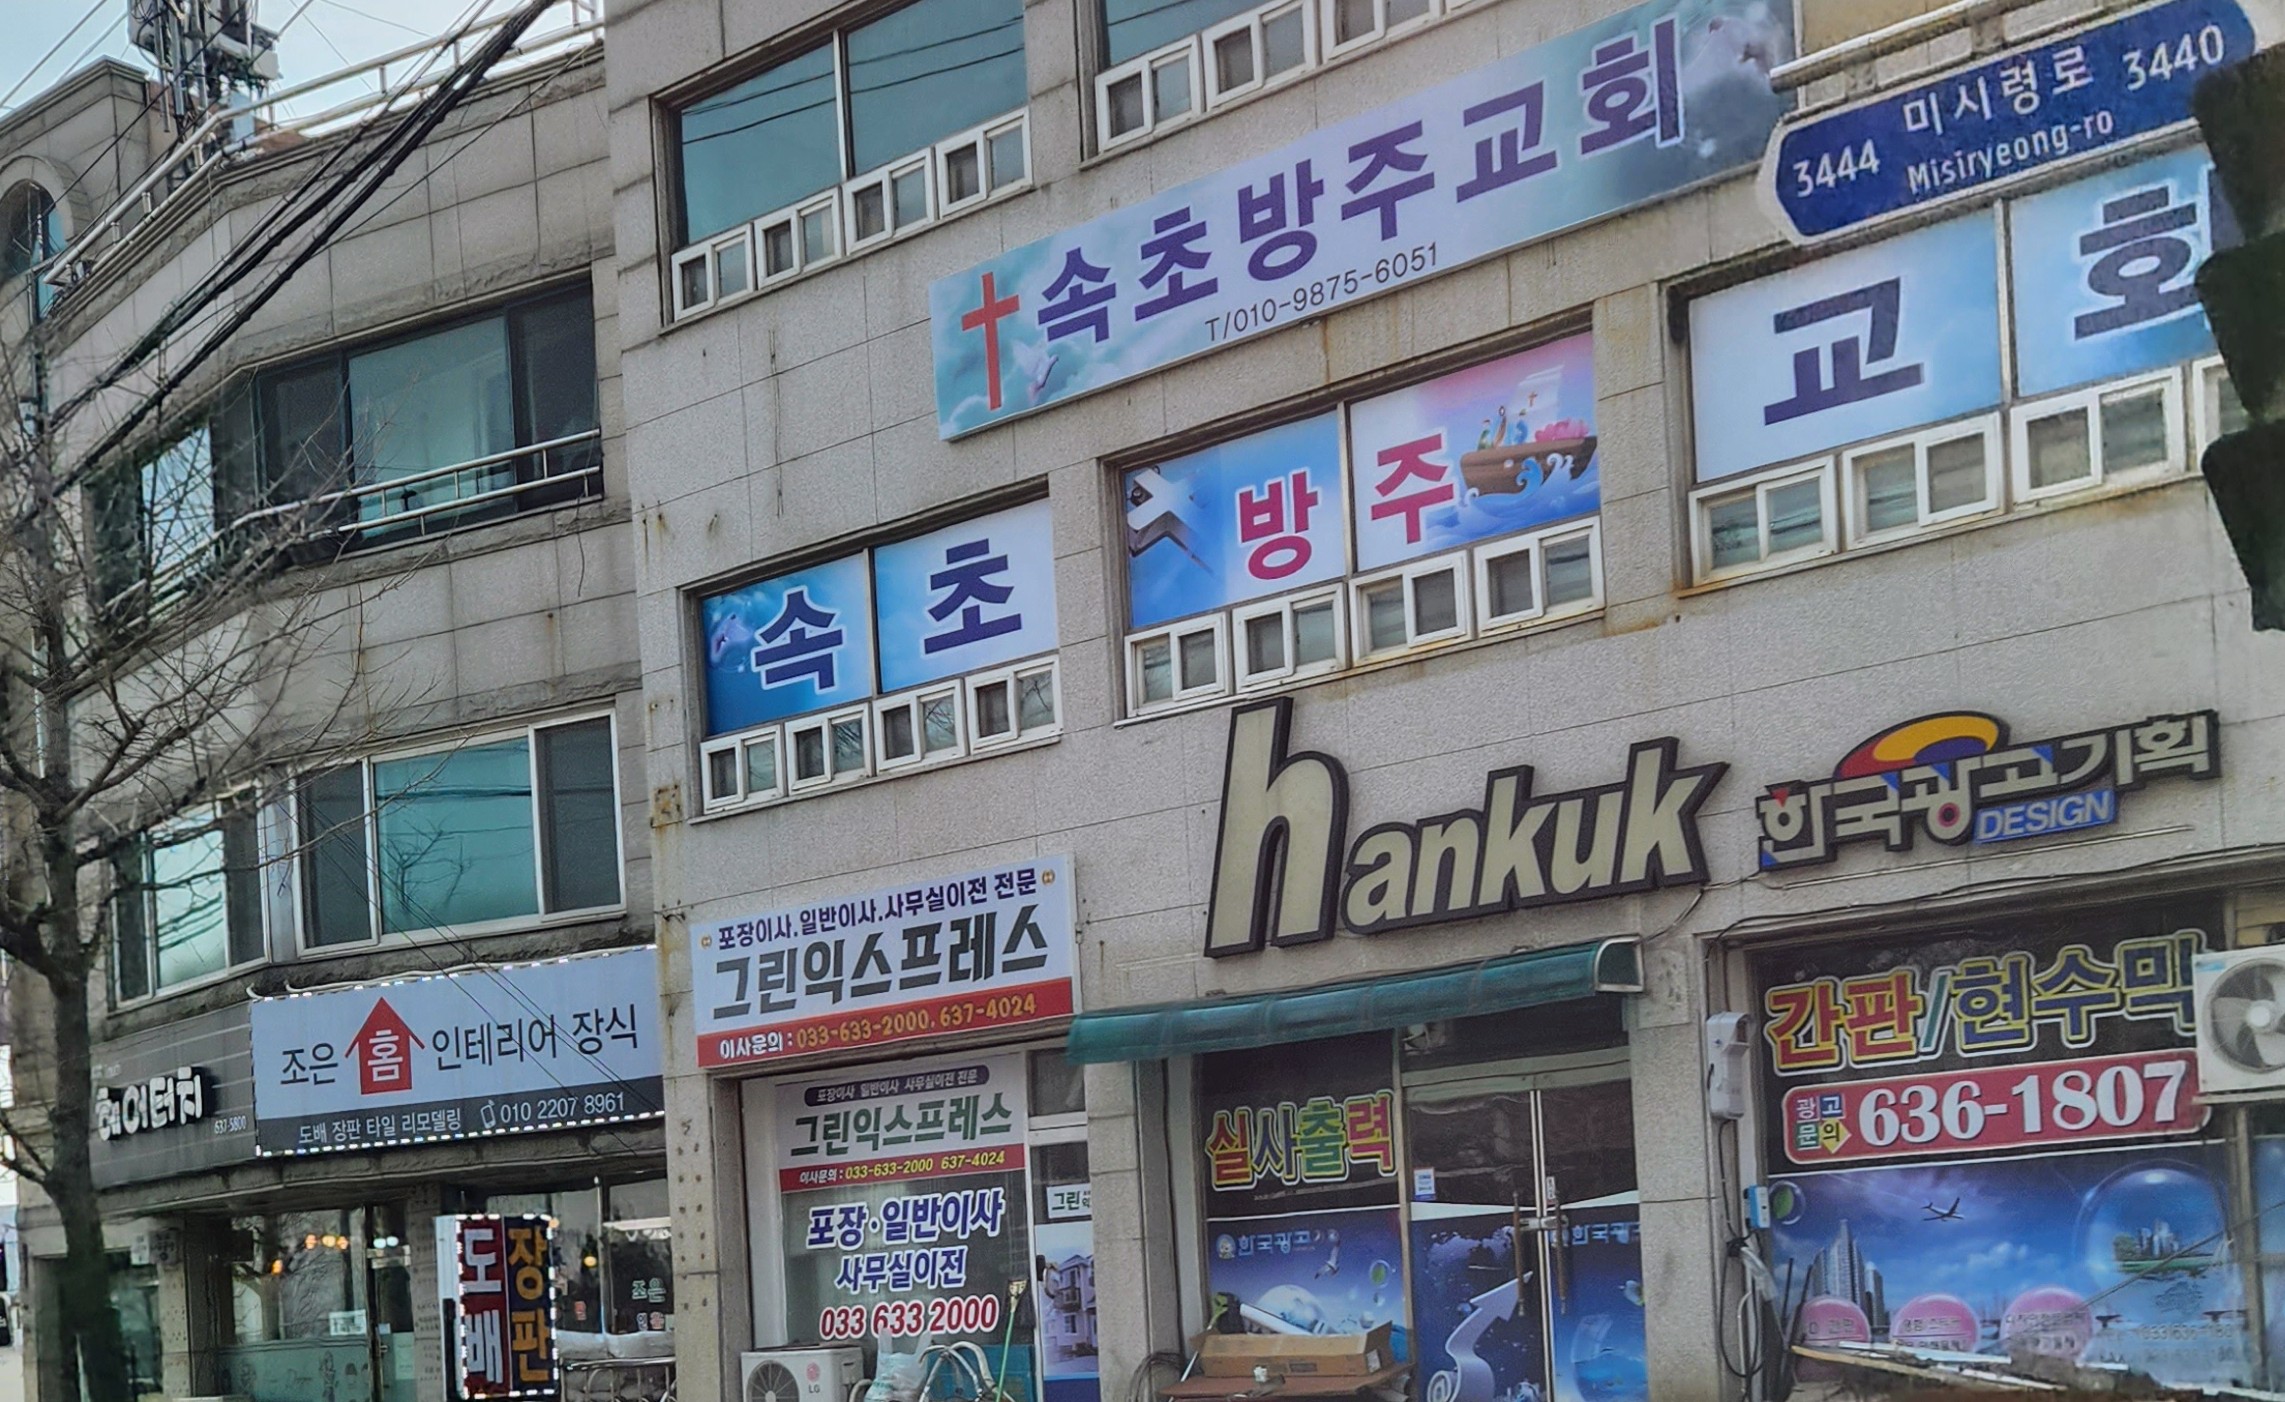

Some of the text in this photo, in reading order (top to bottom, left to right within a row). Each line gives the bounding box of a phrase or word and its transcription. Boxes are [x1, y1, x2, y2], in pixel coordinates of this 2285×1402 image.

[1793, 24, 2226, 198] 3444 미시령로 3440
[1037, 15, 1683, 344] 속초방주교회
[1907, 109, 2114, 196] Misiryeong-ro
[1205, 241, 1437, 341] T/010-9875-6051
[1758, 711, 2215, 869] 한국광고기획
[1976, 792, 2114, 843] DESIGN
[1206, 699, 1724, 955] hankuk
[995, 868, 1037, 900] 전문
[713, 904, 1048, 1019] 그린익스프레스
[280, 1003, 638, 1085] 조은 홈 인테리어 장식
[940, 993, 1036, 1028] 637-4024
[299, 1108, 461, 1144] 도배 장판 타일 리모델링
[500, 1092, 624, 1123] 010 2207 8961
[791, 1093, 1012, 1157] 그린익스프레스
[1858, 1060, 2188, 1146] 636-1807
[845, 1158, 933, 1180] 033-633-2000
[941, 1151, 1005, 1170] 637-4024
[1207, 1091, 1395, 1189] 실사출력
[1052, 1190, 1080, 1210] 그린
[462, 1228, 503, 1384] 도배
[507, 1225, 551, 1381] 장판
[632, 1277, 666, 1303] 조은
[836, 1247, 967, 1293] 사무실이전
[821, 1295, 999, 1339] 033 633 2000
[808, 1384, 820, 1394] LG
